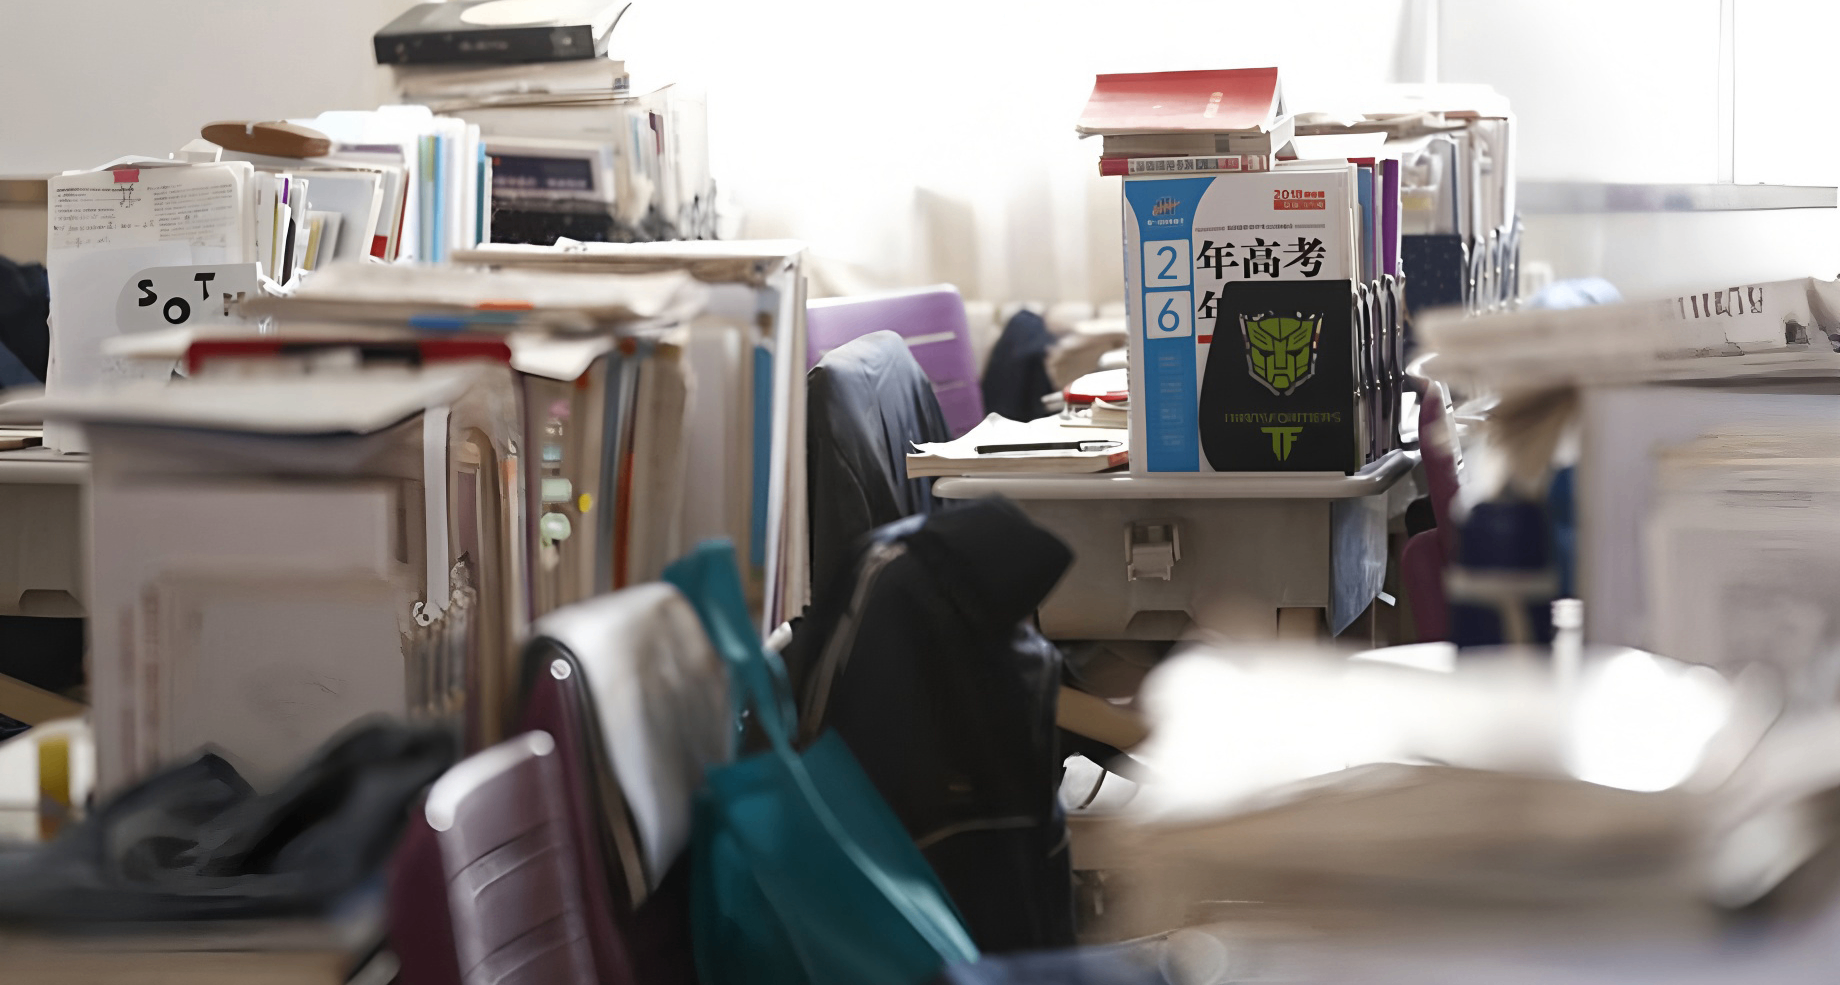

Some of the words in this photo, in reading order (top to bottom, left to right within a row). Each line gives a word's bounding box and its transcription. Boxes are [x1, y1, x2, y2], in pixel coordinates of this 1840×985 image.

[1156, 246, 1178, 280] 2
[1197, 237, 1327, 280] 年高考
[1157, 298, 1180, 332] 6
[1260, 426, 1304, 461] TF
